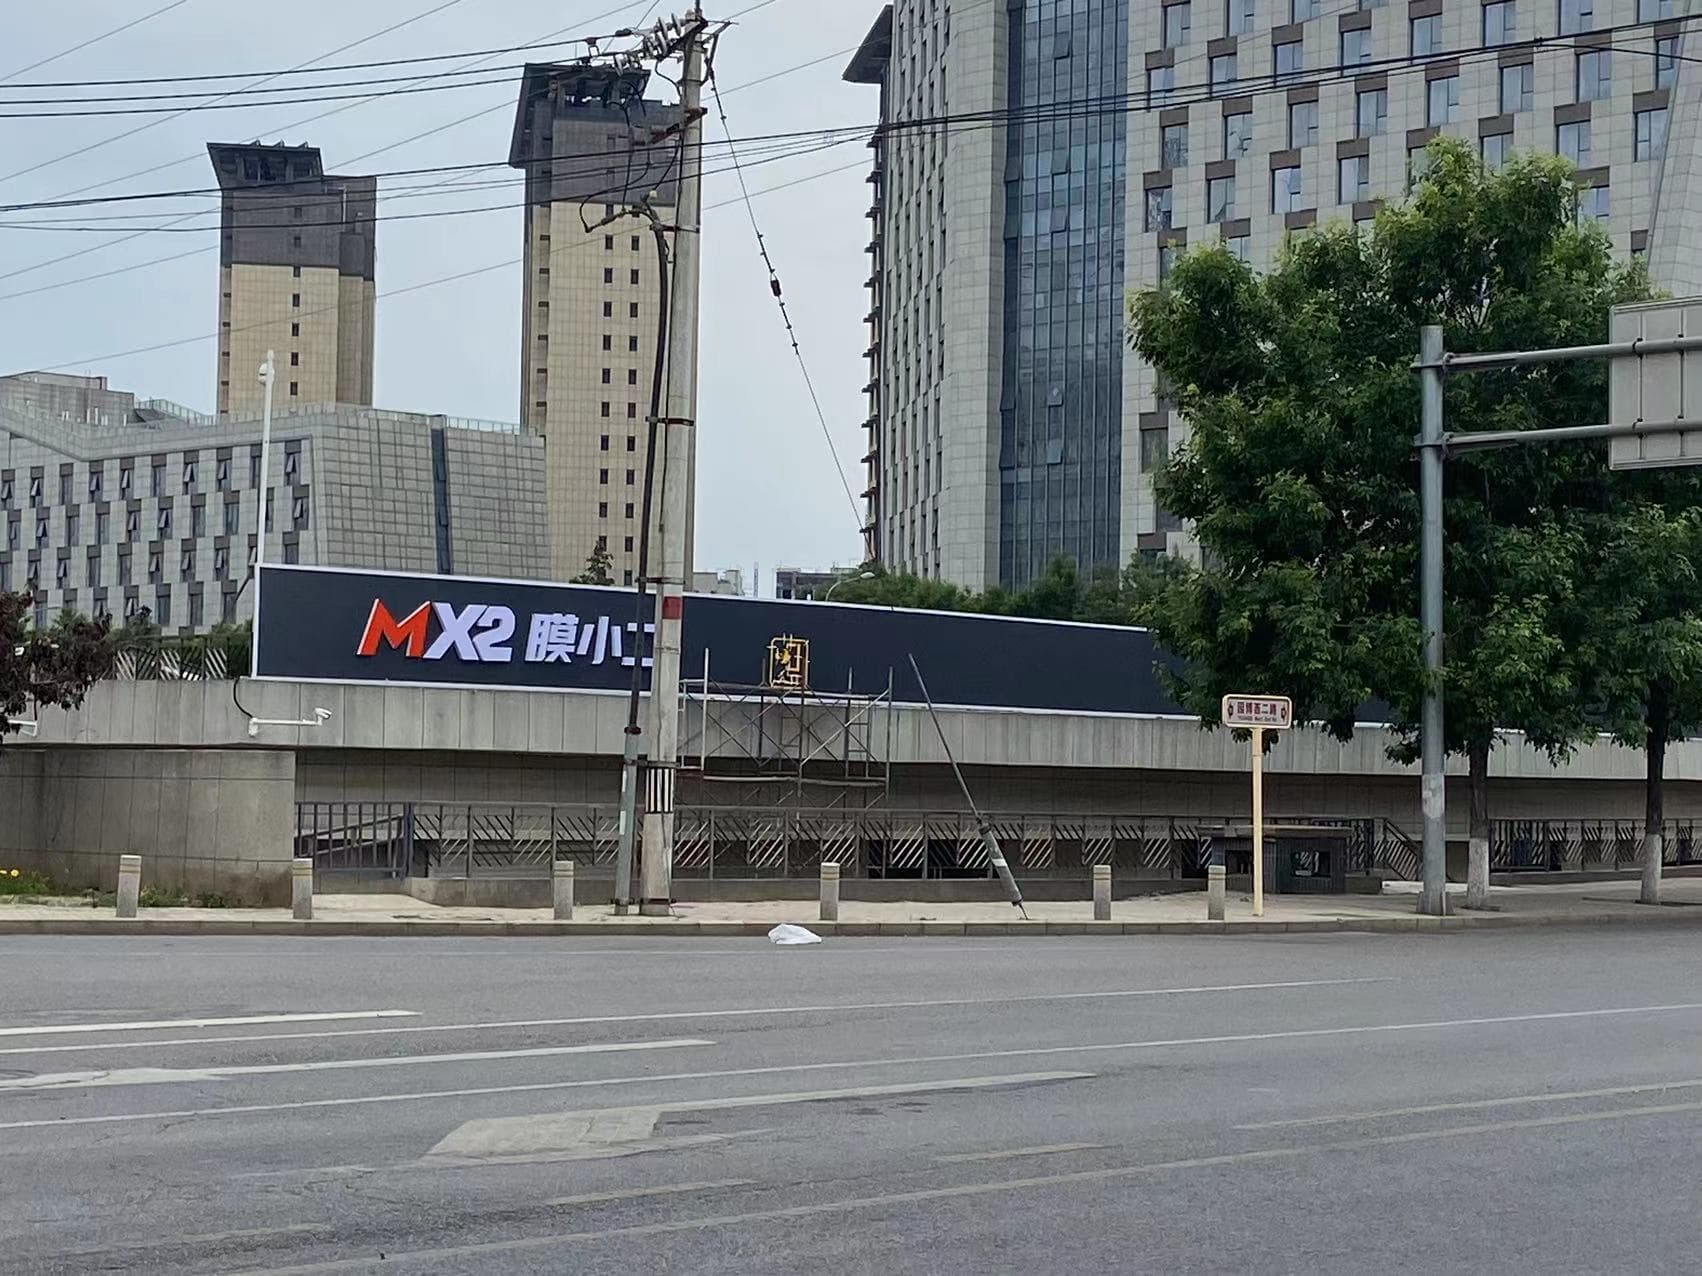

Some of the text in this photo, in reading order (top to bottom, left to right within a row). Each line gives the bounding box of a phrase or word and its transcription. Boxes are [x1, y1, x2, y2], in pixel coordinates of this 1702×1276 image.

[357, 598, 656, 666] MX2 膜小二
